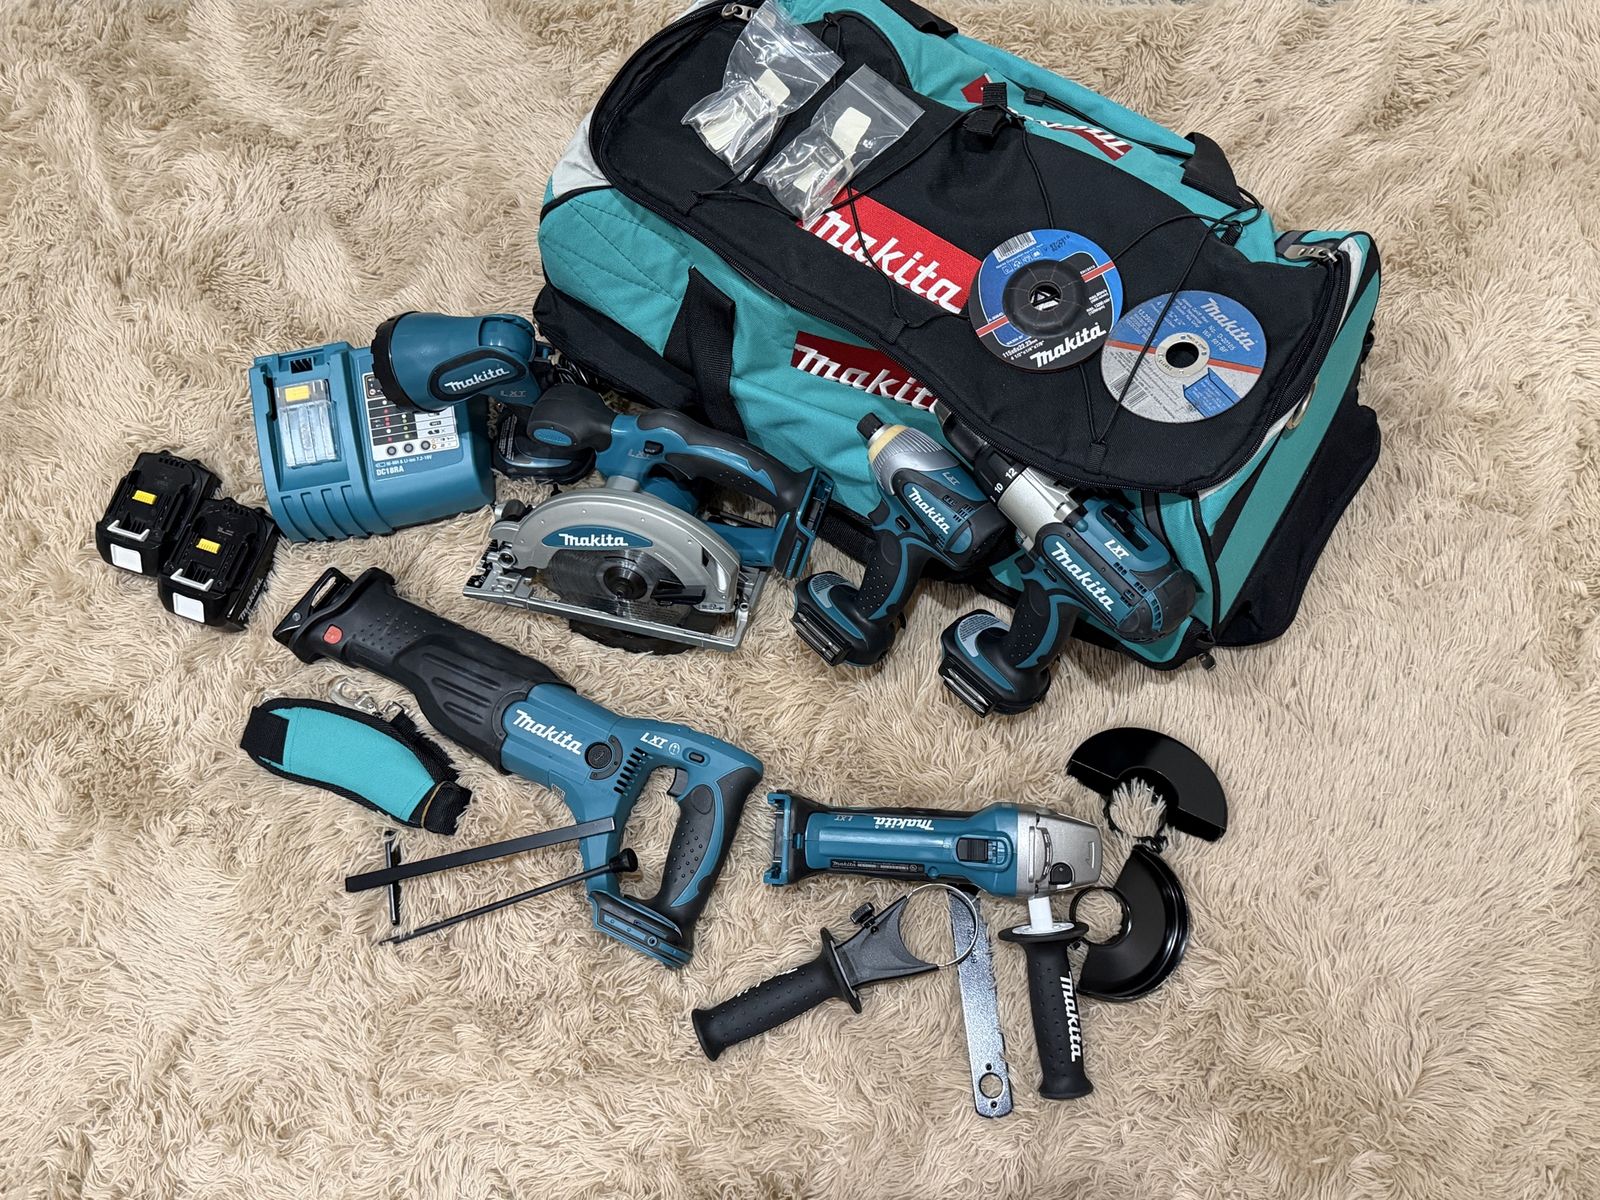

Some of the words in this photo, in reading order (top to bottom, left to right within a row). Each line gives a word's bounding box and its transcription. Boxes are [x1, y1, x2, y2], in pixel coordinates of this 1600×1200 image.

[806, 207, 962, 315] Makita
[1200, 298, 1255, 351] Makita
[1030, 322, 1107, 368] Makita
[444, 365, 510, 392] Makita
[375, 465, 404, 475] DC18RA
[942, 472, 960, 486] LXT
[1004, 466, 1017, 480] 12
[992, 481, 1005, 494] 10
[906, 487, 951, 535] Makita
[558, 533, 629, 547] Makita
[1104, 538, 1130, 560] LXT
[1051, 541, 1117, 611] Makita
[512, 709, 585, 755] Makita
[640, 732, 669, 749] LXT
[873, 816, 935, 831] Makita
[1060, 970, 1082, 1063] Makita
